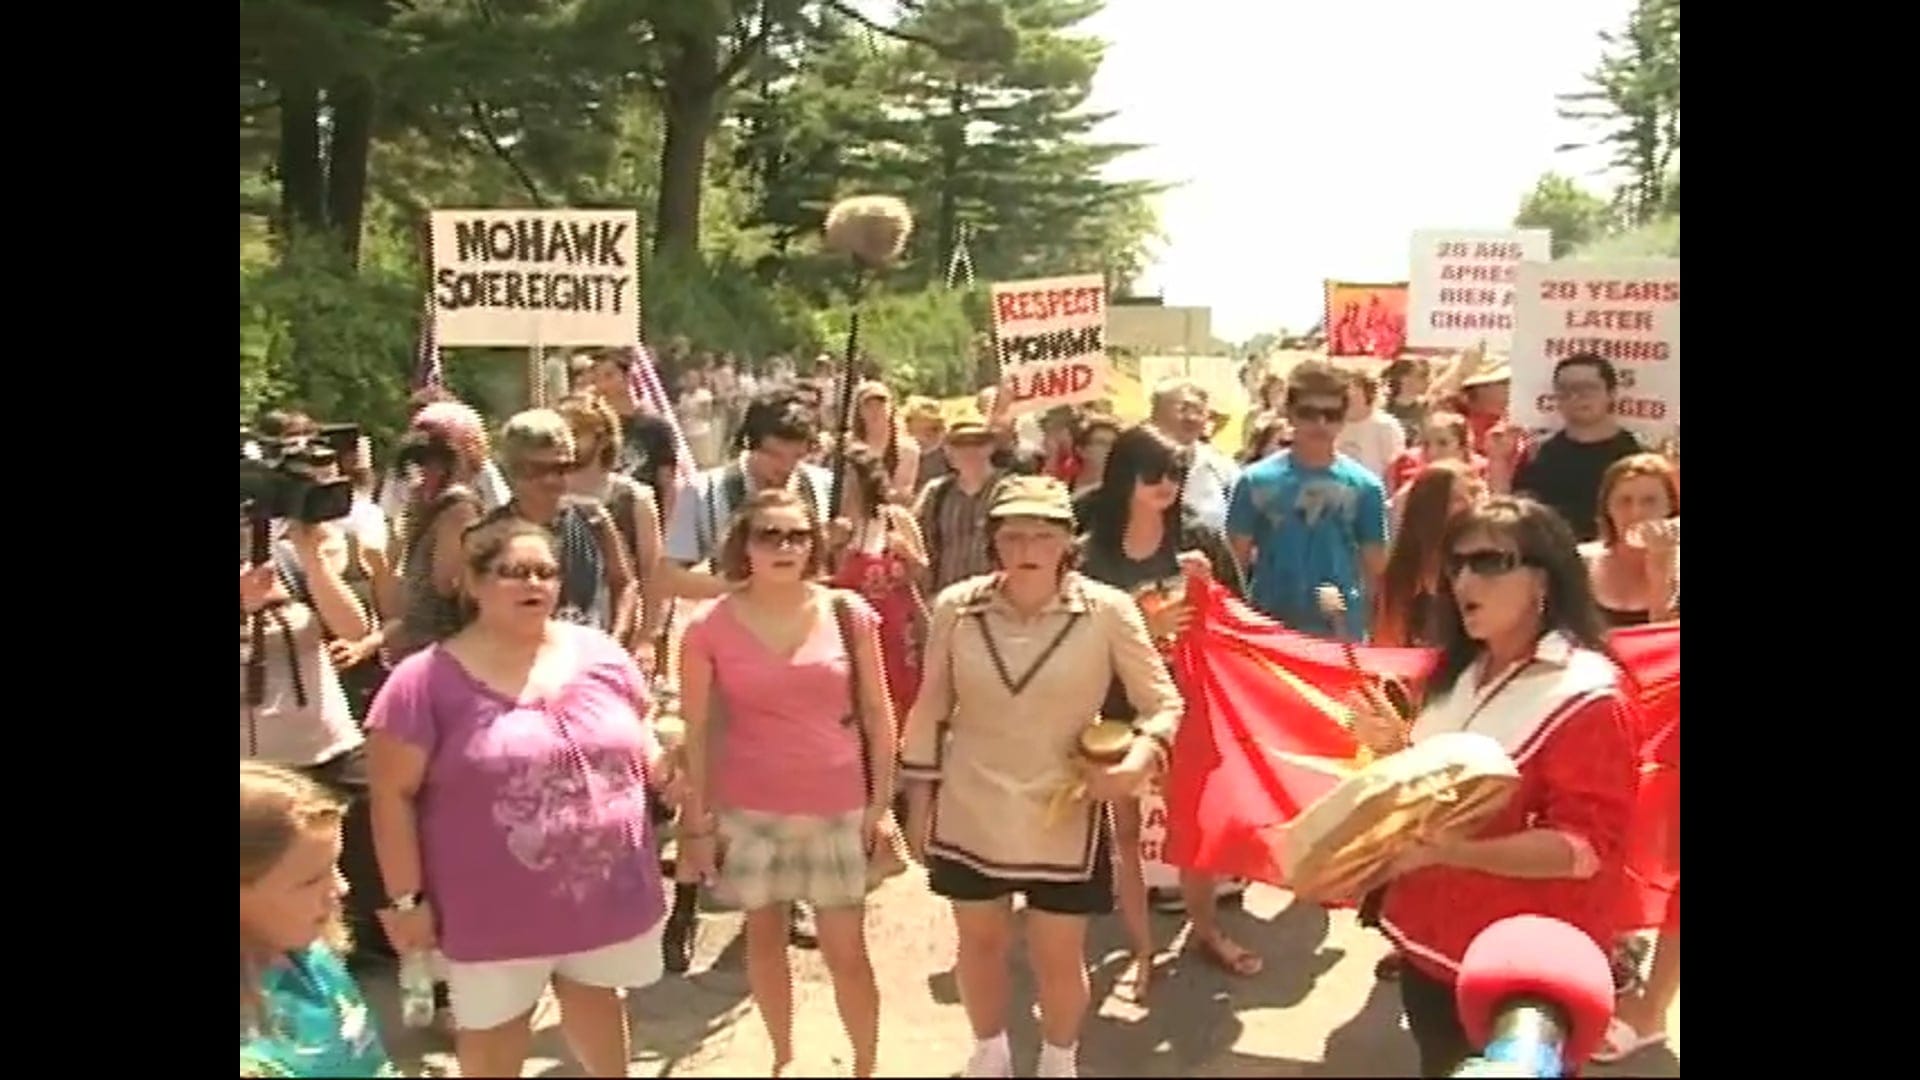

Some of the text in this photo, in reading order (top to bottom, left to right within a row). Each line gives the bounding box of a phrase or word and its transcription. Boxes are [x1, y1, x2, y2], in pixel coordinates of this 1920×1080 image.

[455, 219, 628, 267] MOHAWK
[1474, 242, 1523, 258] ANS
[437, 268, 629, 314] SOVEREIGNTY
[996, 286, 1103, 323] RESPECT
[1540, 281, 1679, 301] 20 YEARS
[1430, 310, 1512, 329] CHANG
[1567, 310, 1653, 330] LATER
[1000, 325, 1101, 365] MOHAWK
[1545, 338, 1669, 361] NOTHING
[1011, 363, 1094, 402] LAND
